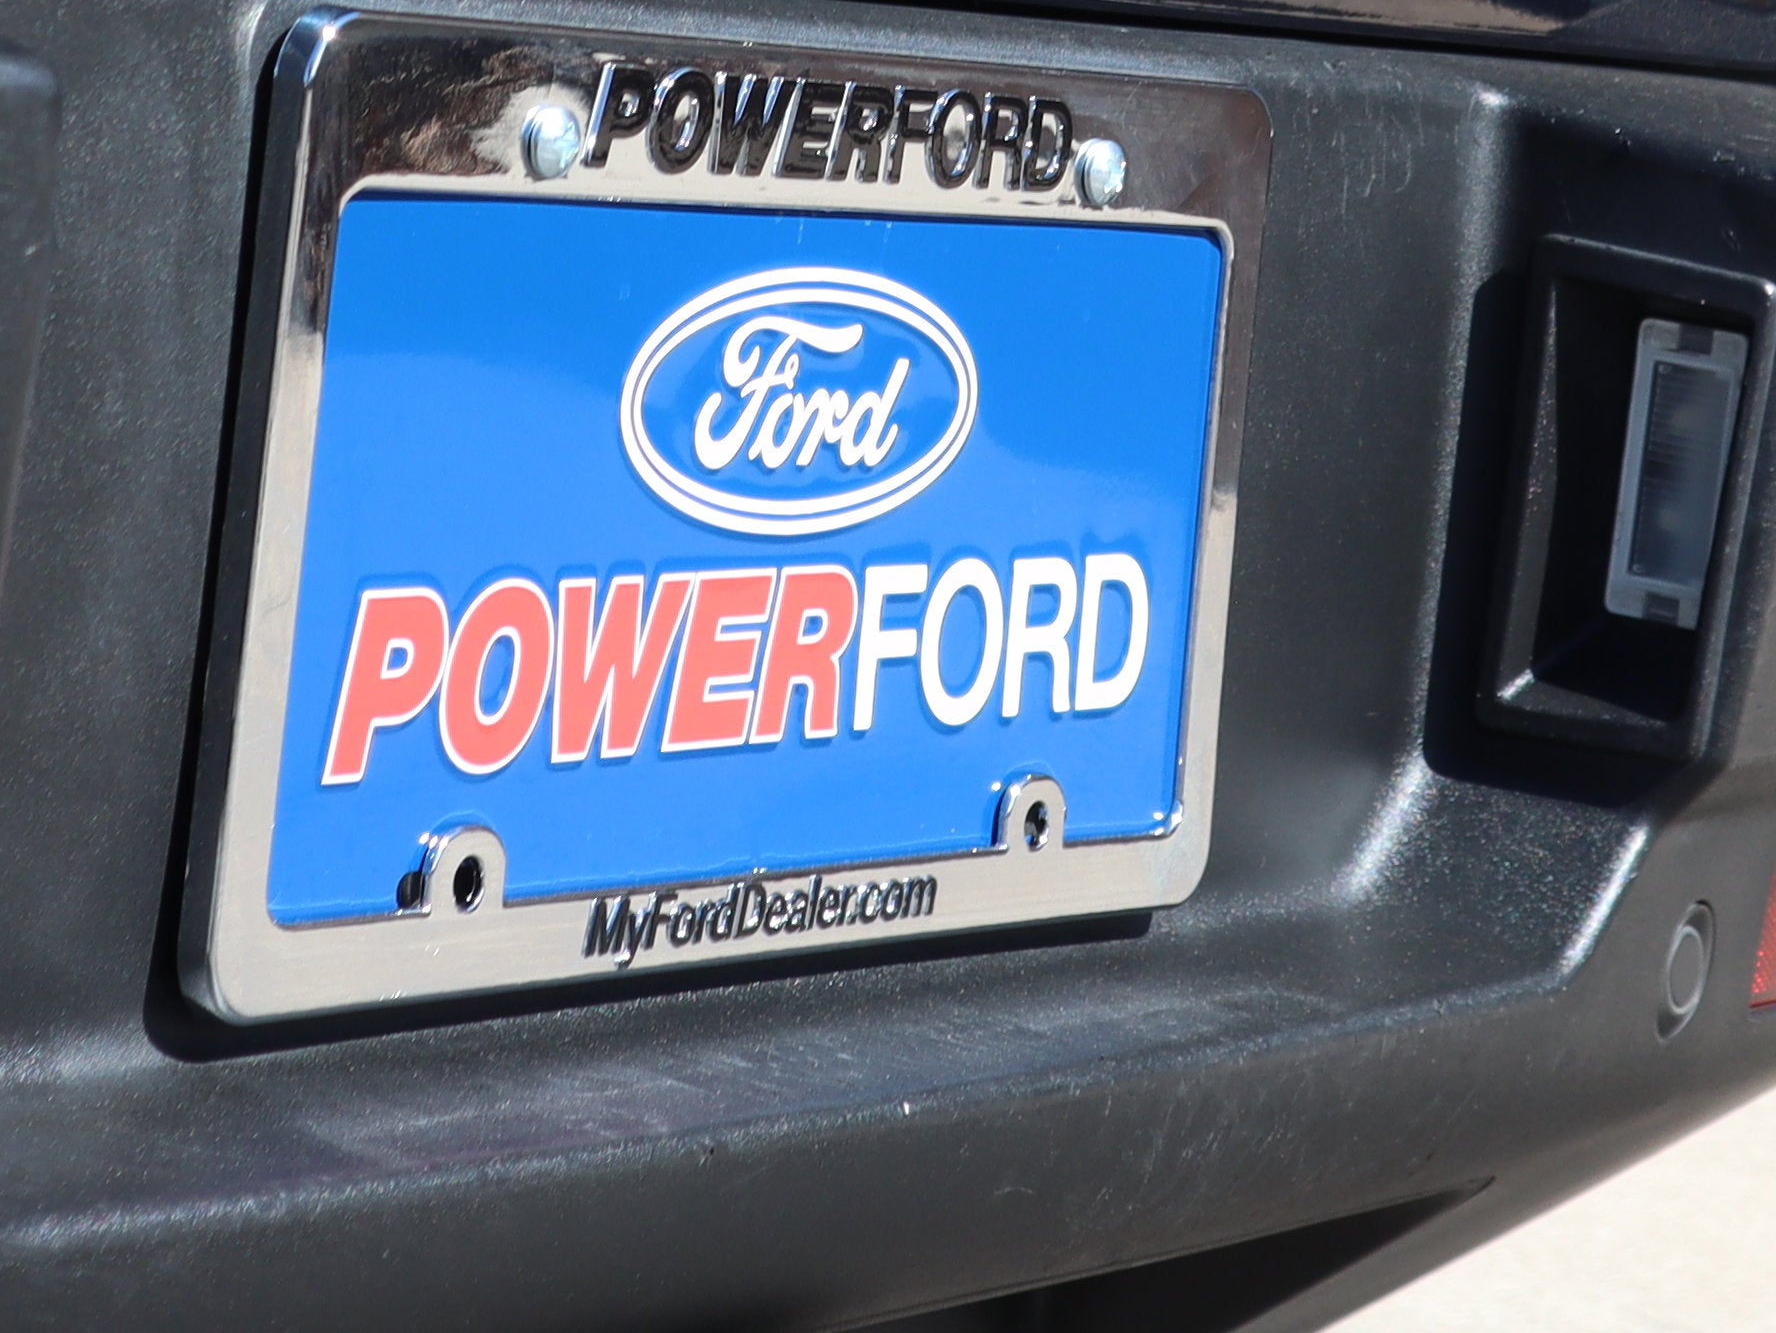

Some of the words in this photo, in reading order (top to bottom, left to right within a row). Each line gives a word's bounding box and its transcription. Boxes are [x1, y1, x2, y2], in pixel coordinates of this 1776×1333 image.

[580, 61, 1074, 192] POWERFORD
[693, 315, 911, 473] Ford
[320, 552, 1150, 785] POWERFORD
[582, 873, 937, 969] MyFordDealer.com
